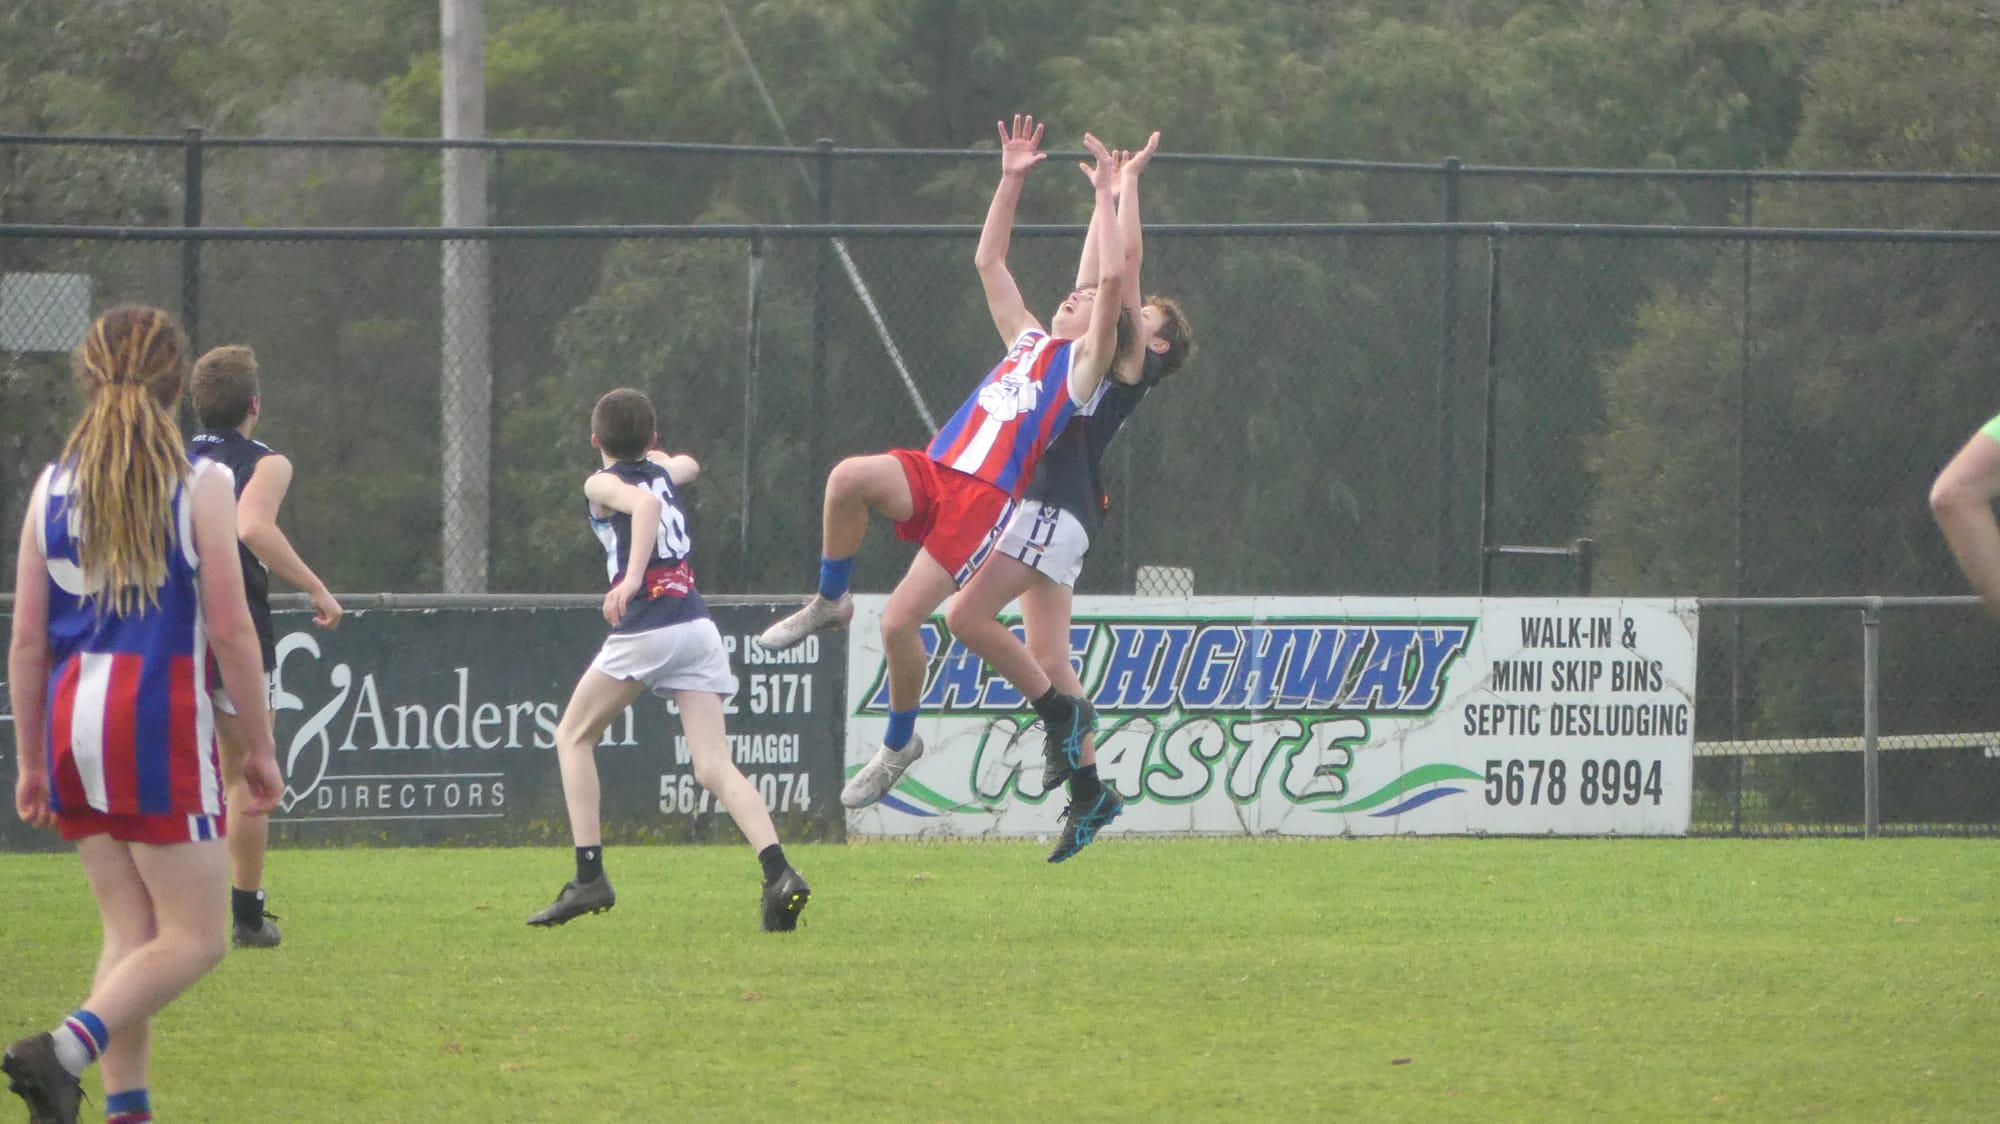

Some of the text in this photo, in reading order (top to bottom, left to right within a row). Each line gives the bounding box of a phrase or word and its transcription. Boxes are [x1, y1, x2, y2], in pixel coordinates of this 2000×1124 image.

[1520, 616, 1637, 649] WALK-IN &
[1094, 624, 1470, 711] HIGHWAY
[1491, 660, 1664, 693] MINI SKIP BINS
[338, 667, 639, 750] Andersn
[749, 673, 813, 714] 5171
[1463, 703, 1689, 737] SEPTIC DESLUDGING
[674, 733, 800, 764] WTHAGGI
[317, 783, 505, 810] DIRECTORS
[1484, 758, 1664, 806] 5678 8994
